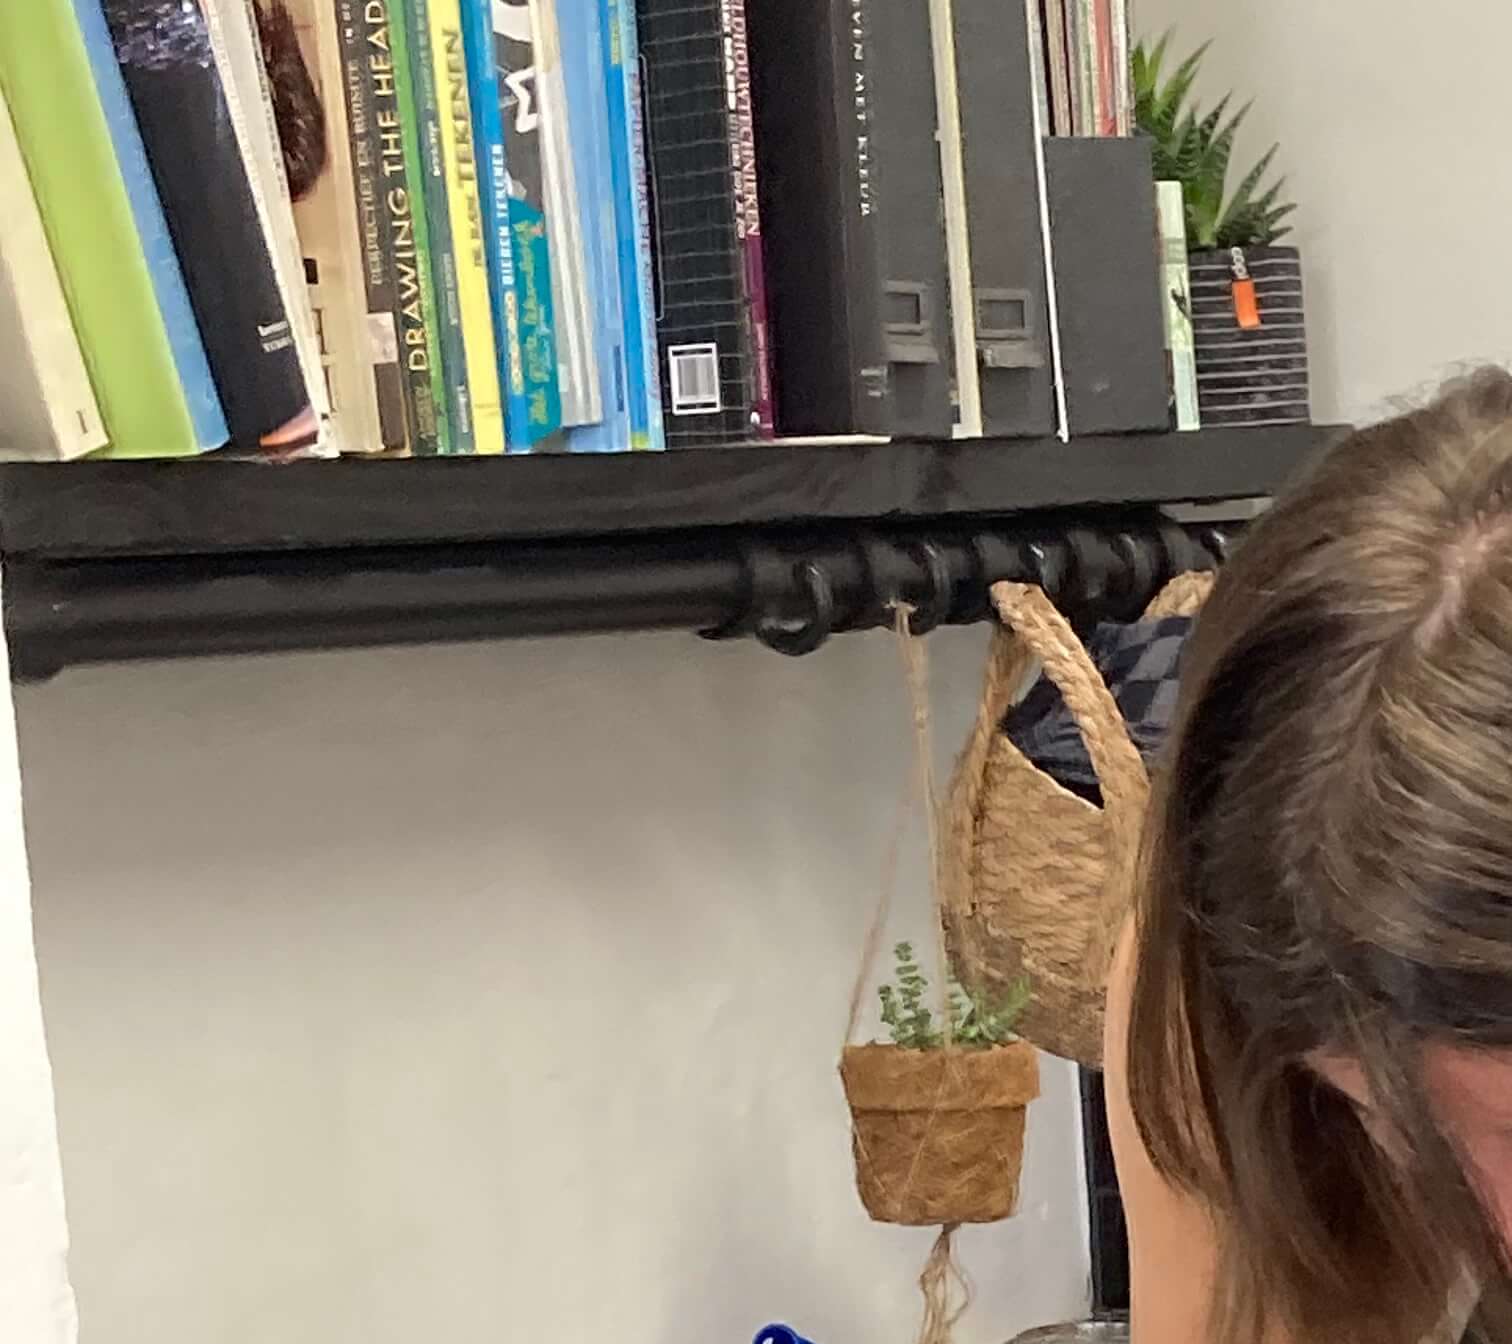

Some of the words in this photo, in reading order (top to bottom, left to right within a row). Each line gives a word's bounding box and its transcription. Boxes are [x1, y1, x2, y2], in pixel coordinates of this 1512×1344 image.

[363, 0, 395, 96] HEAD
[442, 27, 475, 187] TEKENEN
[854, 71, 868, 122] MET
[376, 110, 404, 177] THE
[856, 135, 873, 217] KLEUR
[387, 187, 429, 372] DRAWING
